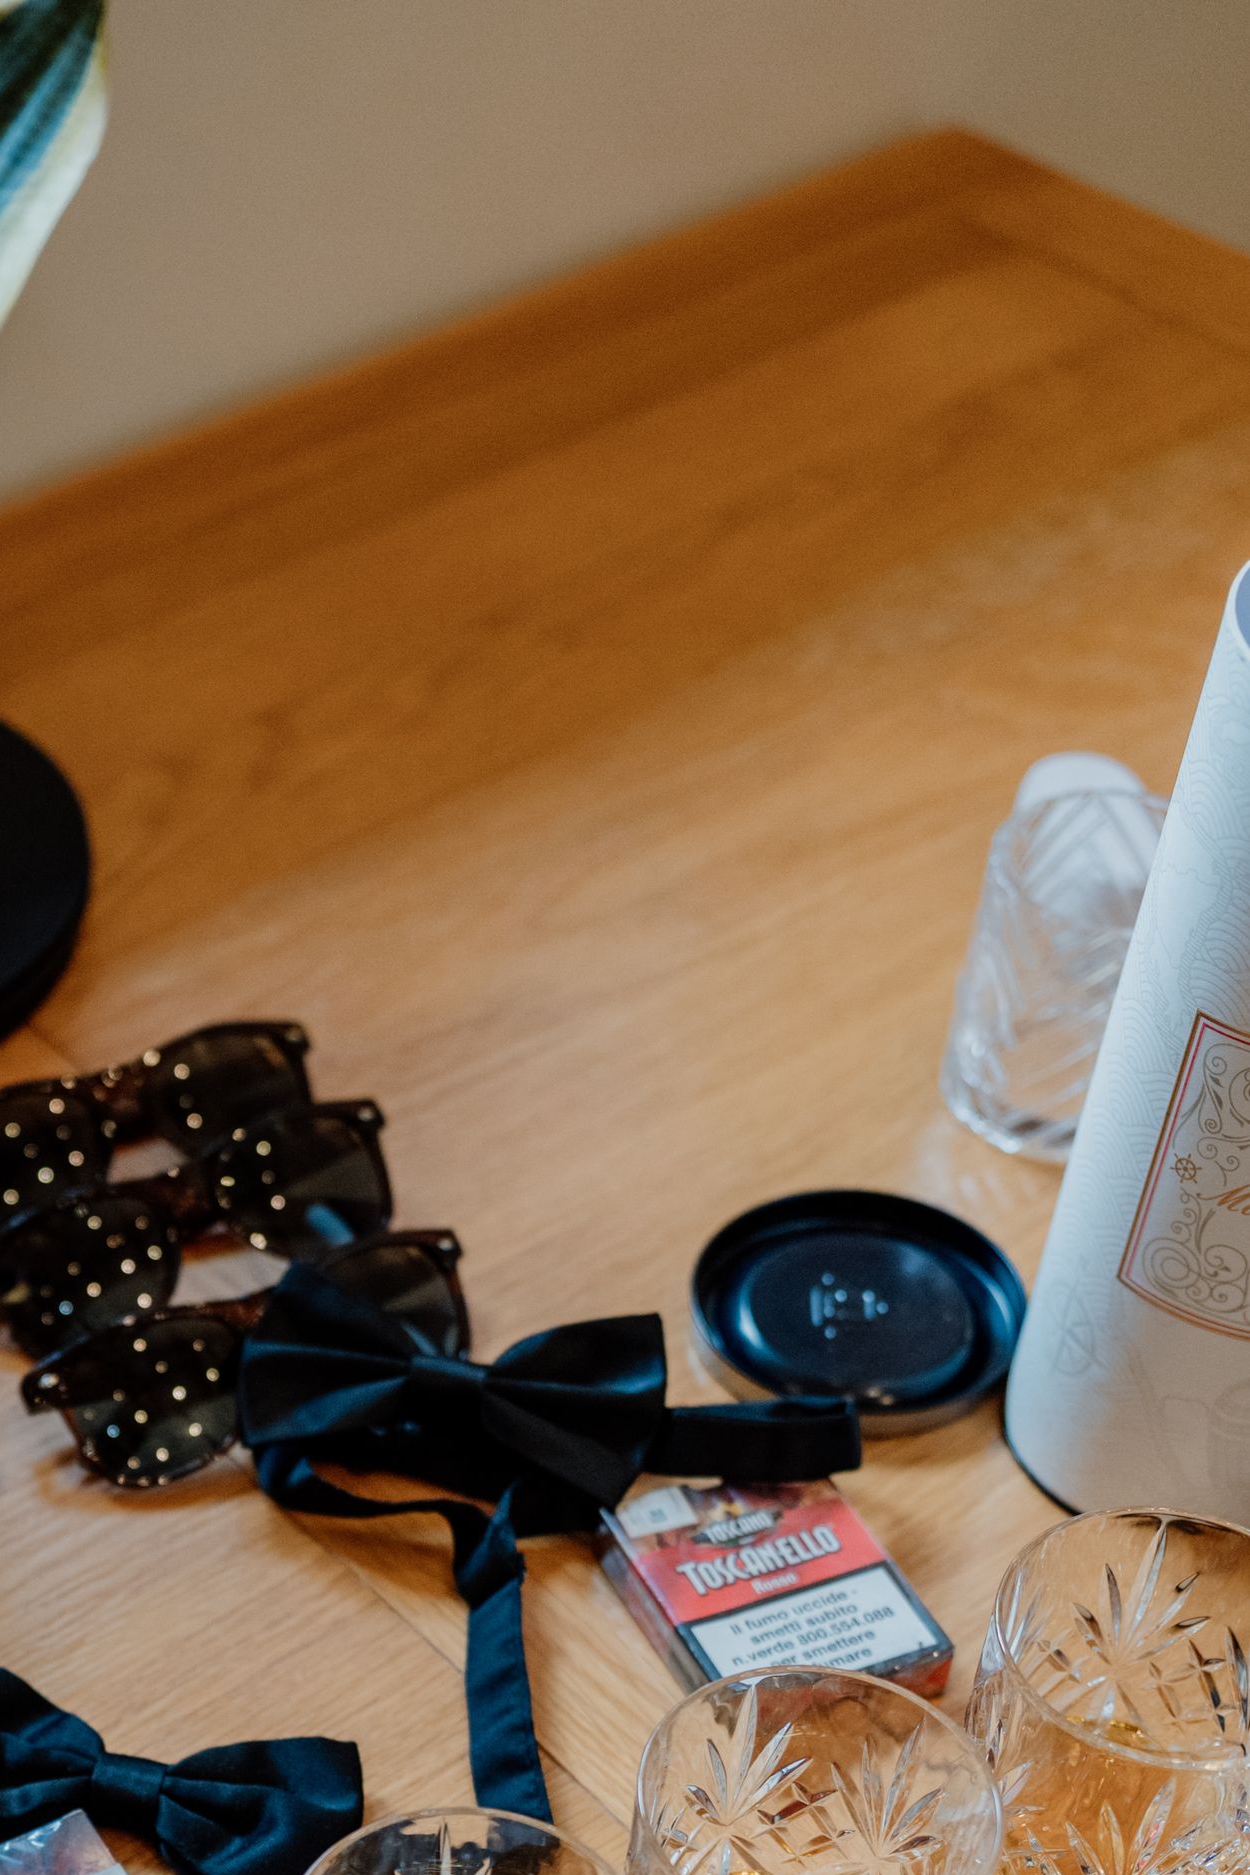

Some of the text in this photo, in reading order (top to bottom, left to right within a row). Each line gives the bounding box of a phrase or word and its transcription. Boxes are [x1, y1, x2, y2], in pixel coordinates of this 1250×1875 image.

[674, 1523, 843, 1597] TOSCANELLO
[744, 1609, 789, 1630] fumo
[792, 1591, 848, 1616] uccide
[749, 1604, 858, 1646] smetti subito
